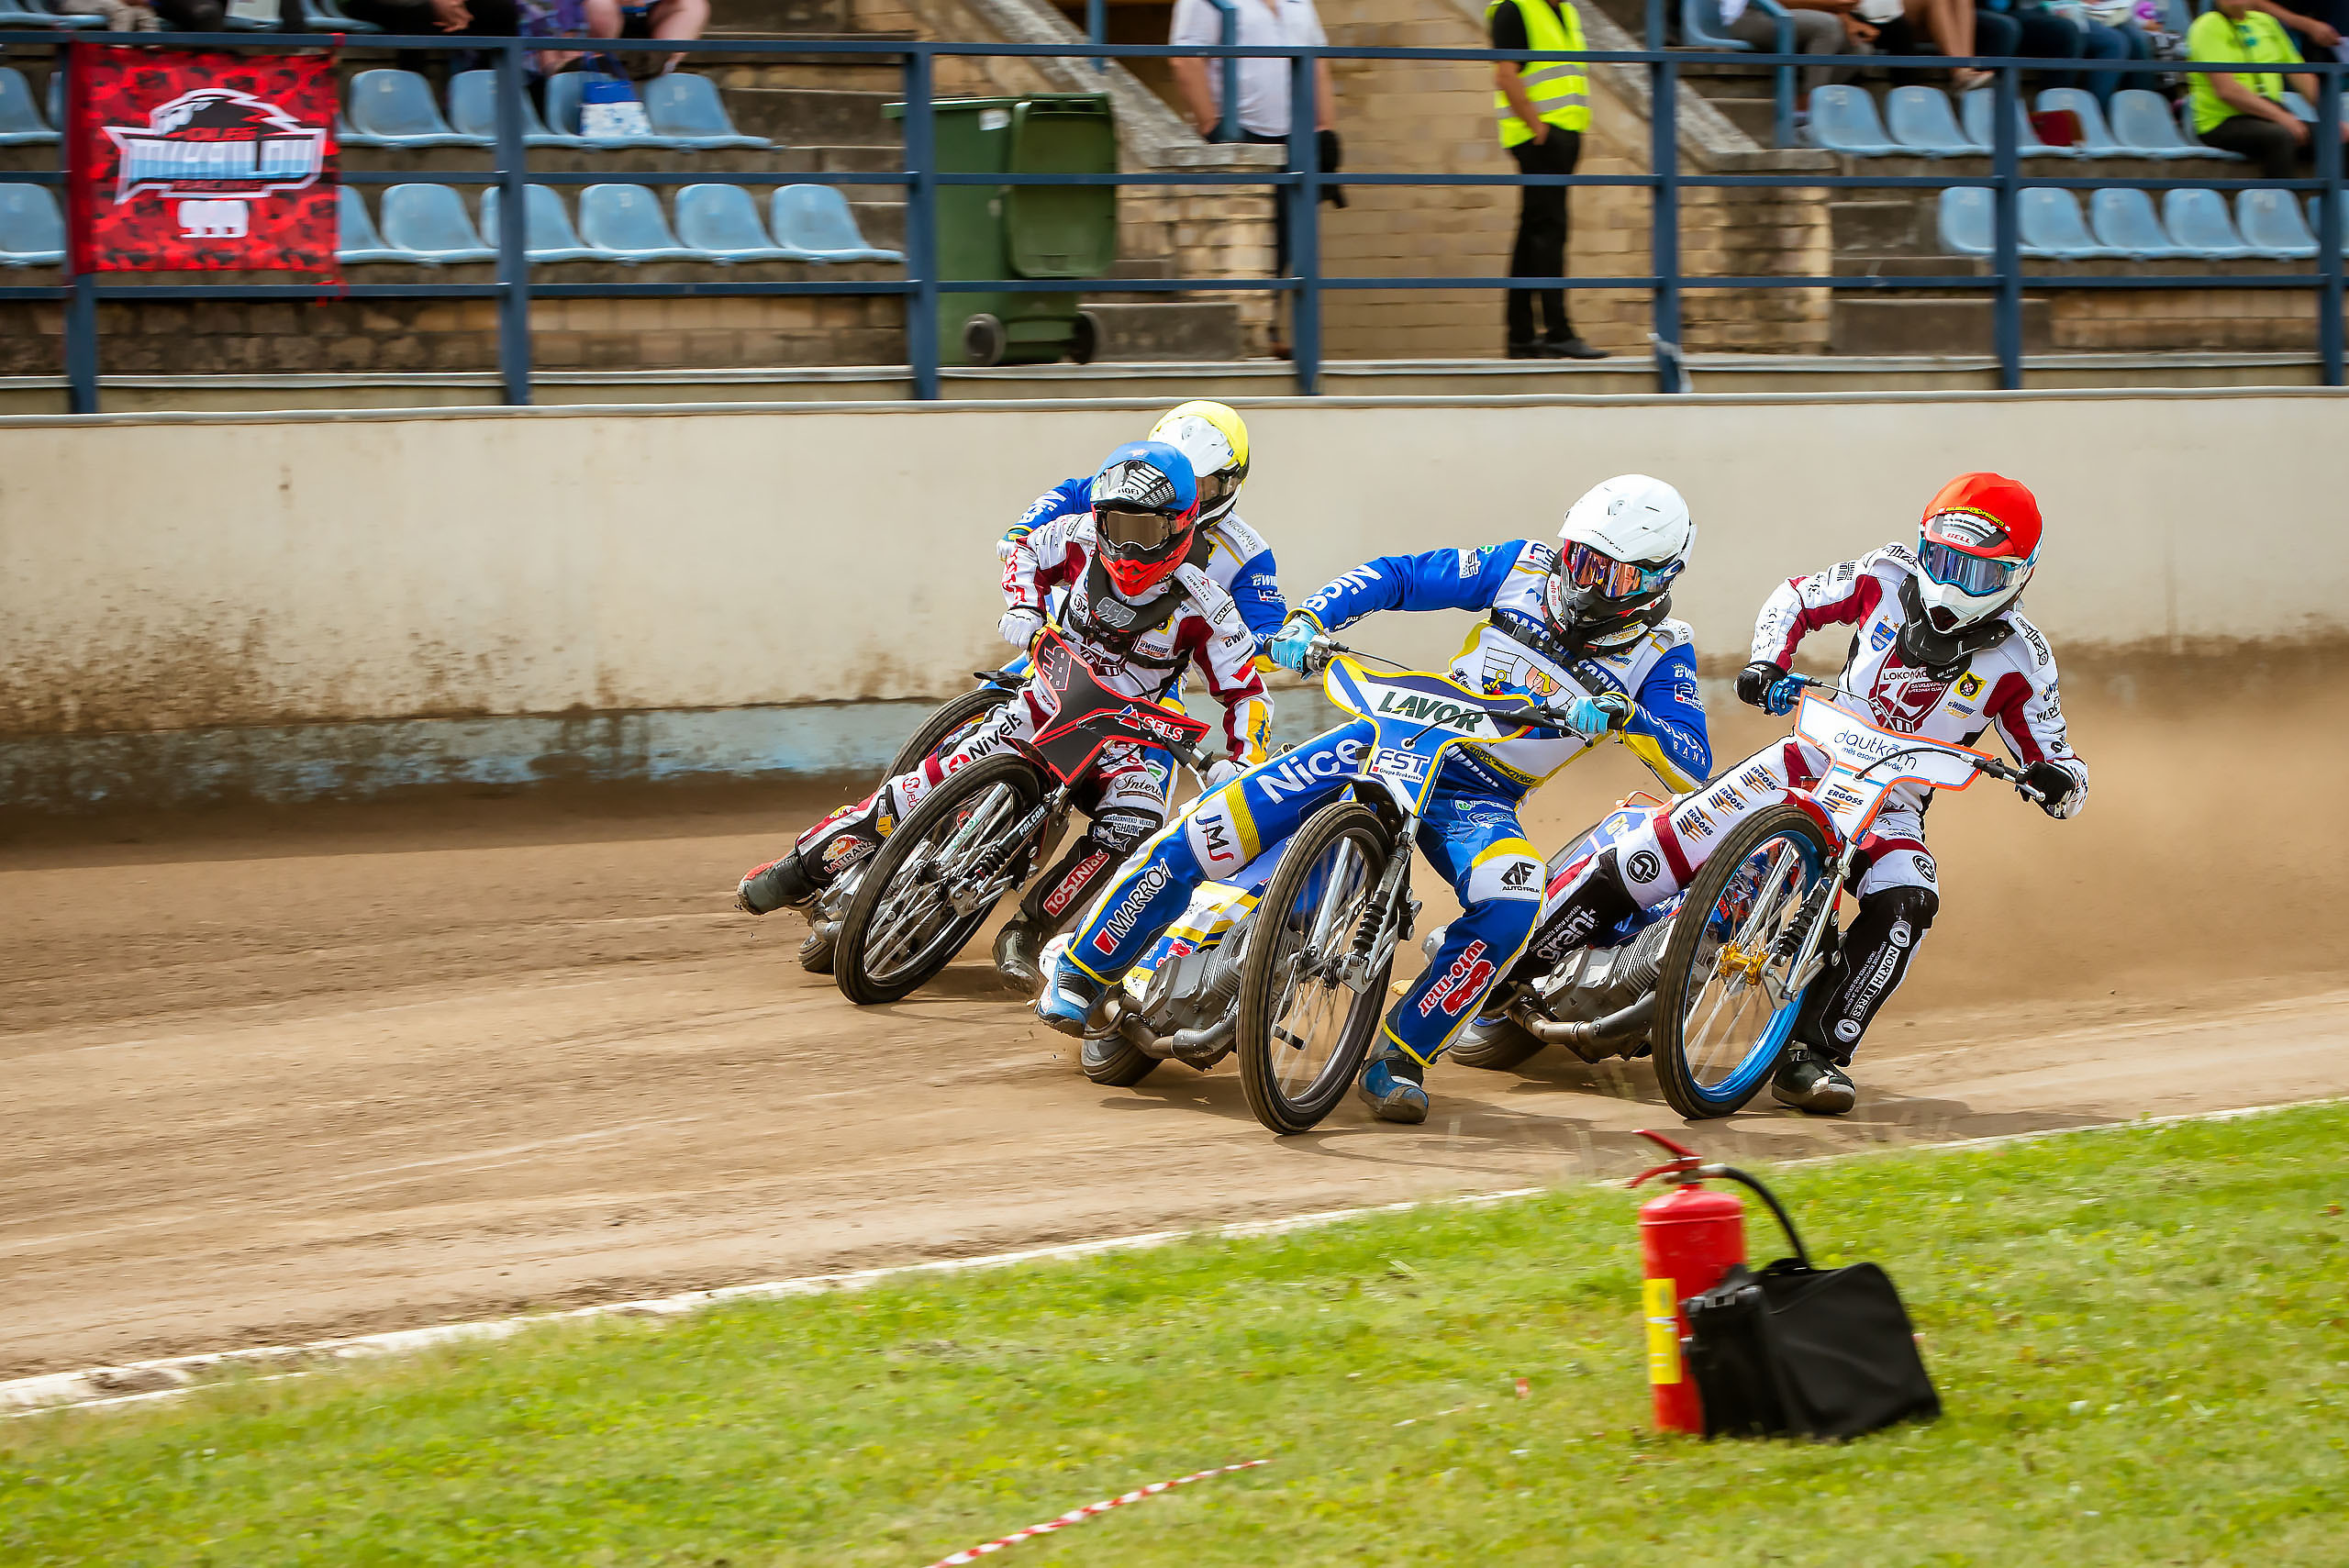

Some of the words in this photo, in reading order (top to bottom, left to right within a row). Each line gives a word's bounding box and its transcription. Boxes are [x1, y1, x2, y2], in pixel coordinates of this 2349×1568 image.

[1946, 532, 1971, 544] BELL
[1301, 564, 1383, 612] Nice
[1377, 691, 1484, 733] LAVOR
[1375, 750, 1430, 773] FST
[1673, 740, 1707, 766] BANK
[1255, 739, 1364, 805] Nice
[1751, 766, 1777, 791] ERGOSS
[1719, 787, 1745, 811] ERGOSS
[1827, 788, 1865, 806] ERGOSS
[1019, 804, 1047, 837] FALCON
[1687, 808, 1714, 837] ERGOSS
[1873, 947, 1898, 989] NORTH
[1853, 983, 1879, 1018] TYRES
